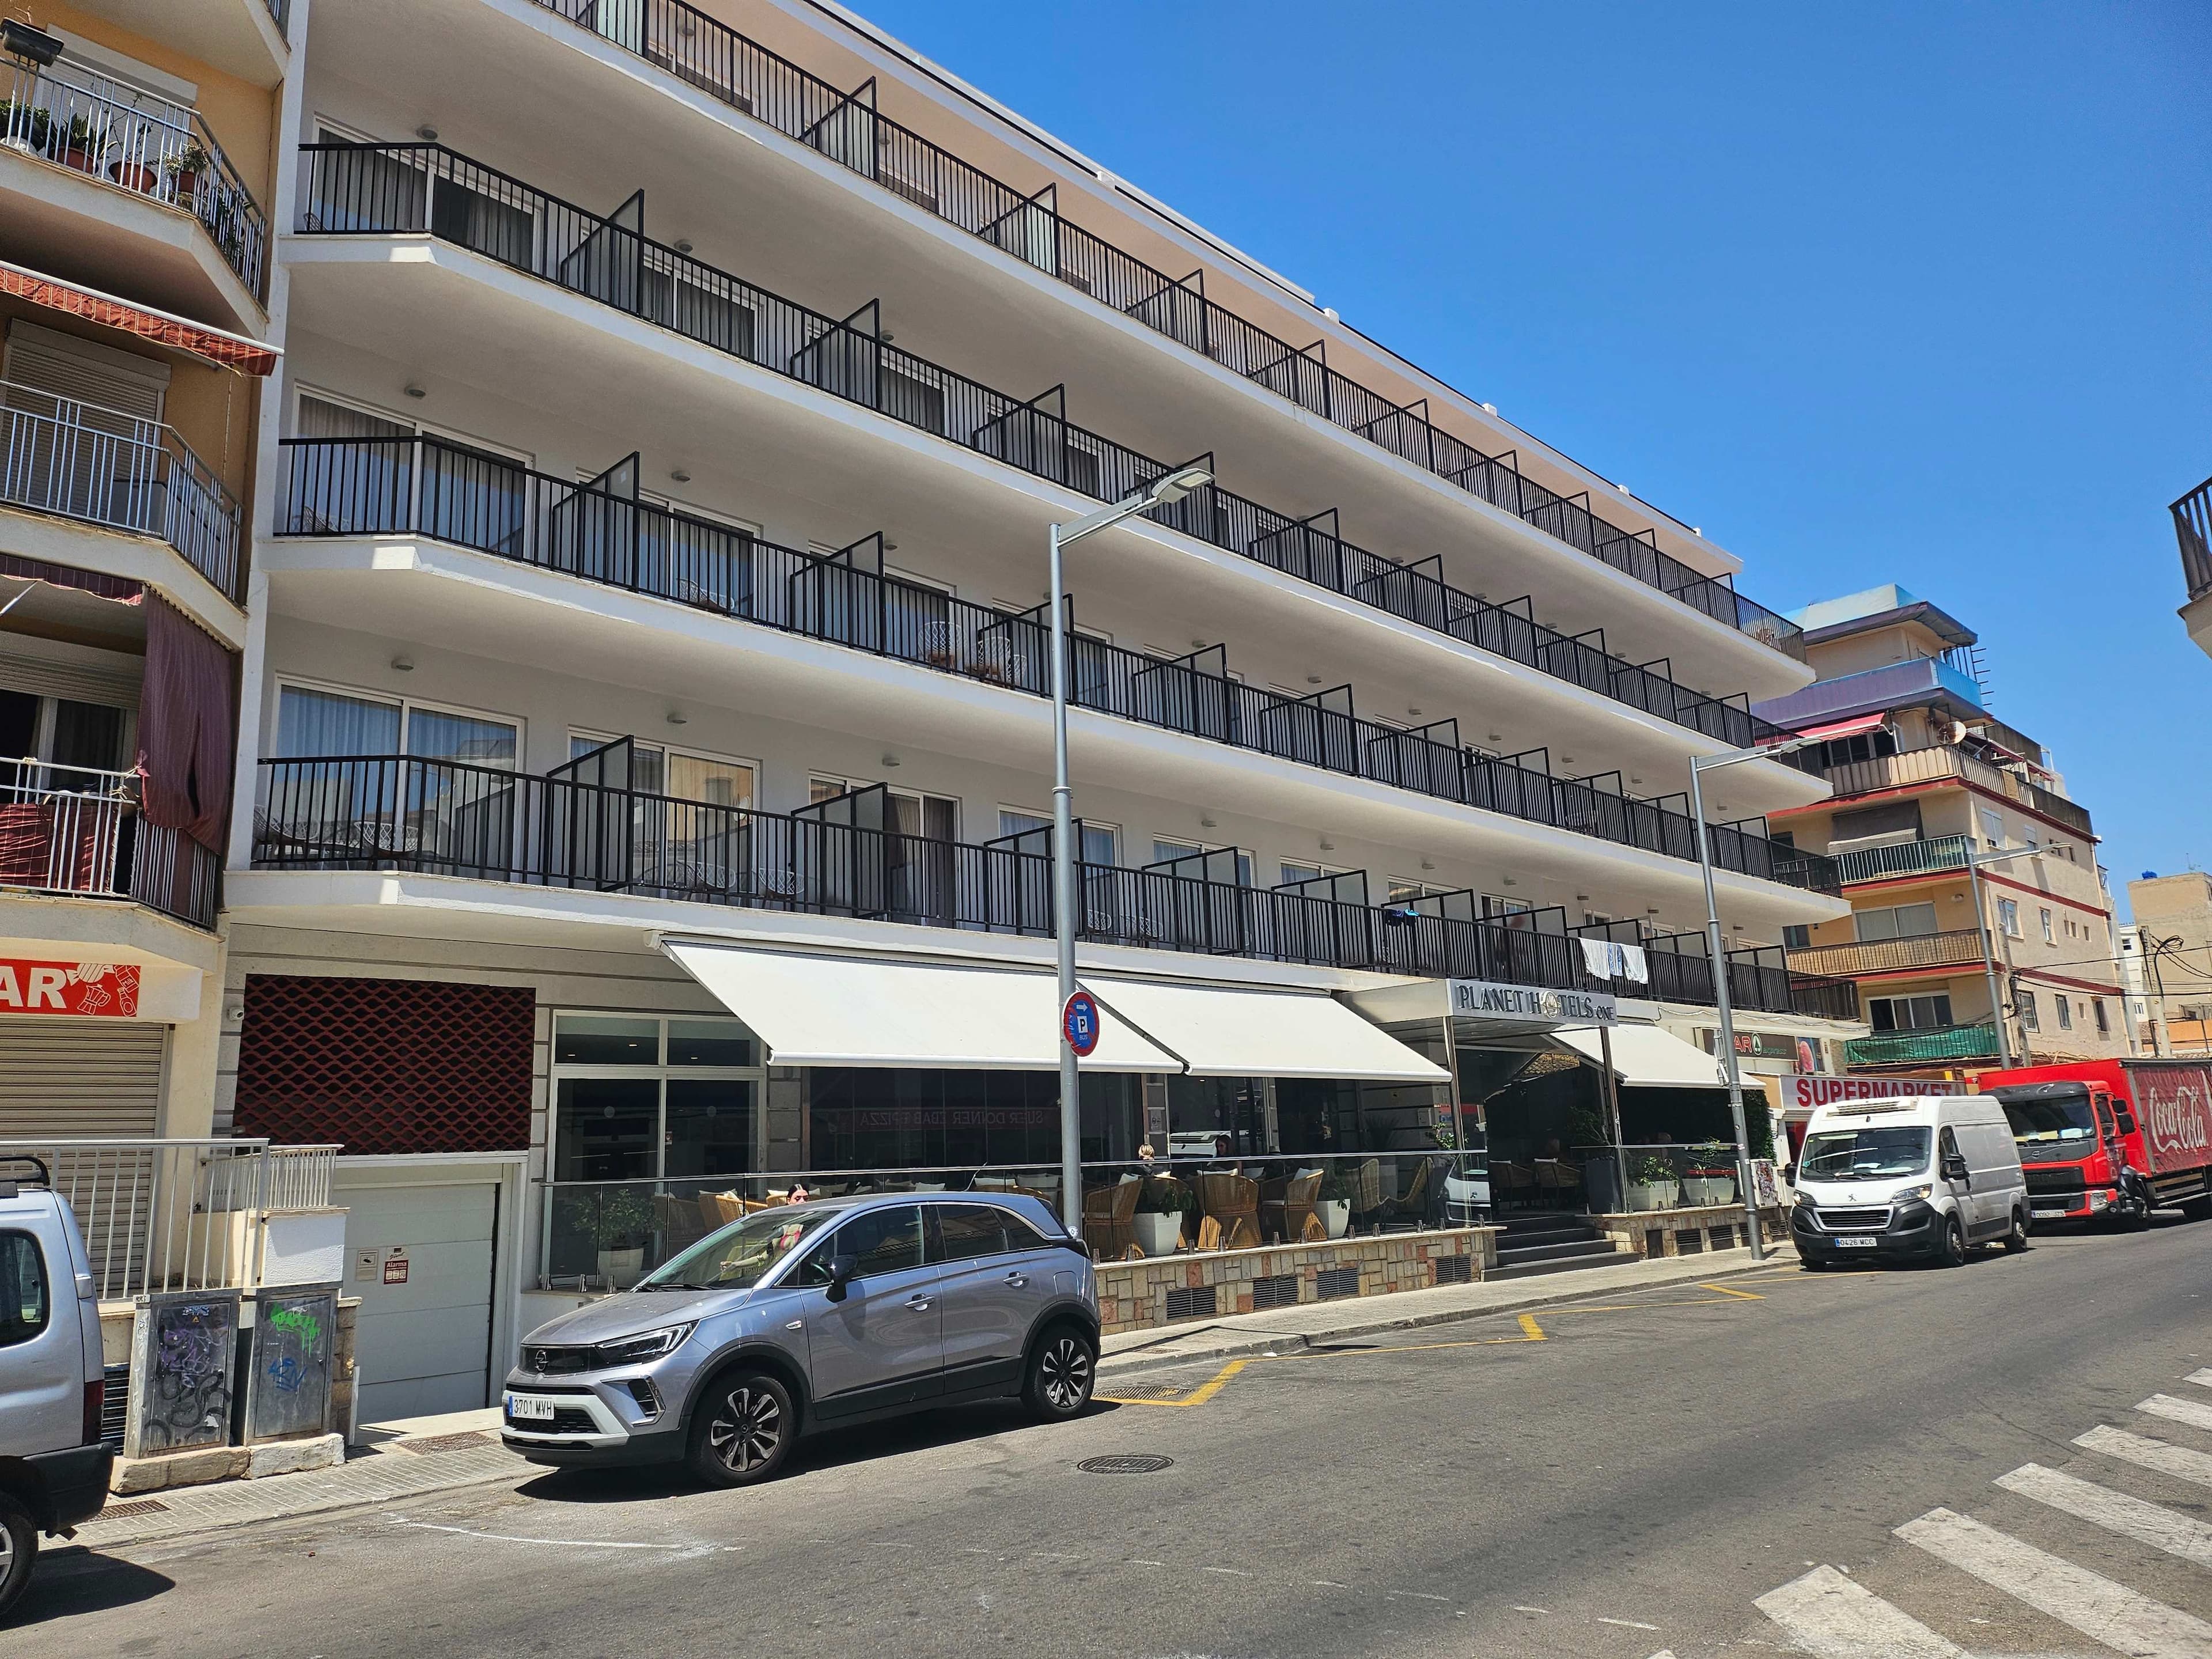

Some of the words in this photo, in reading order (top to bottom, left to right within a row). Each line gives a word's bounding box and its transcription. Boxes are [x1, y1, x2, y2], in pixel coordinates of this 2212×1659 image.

[1456, 985, 1523, 1013] PLANET
[1596, 1005, 1615, 1020] ONE
[1080, 1018, 1086, 1032] P
[514, 1399, 532, 1415] 3701
[536, 1400, 552, 1416] MVH
